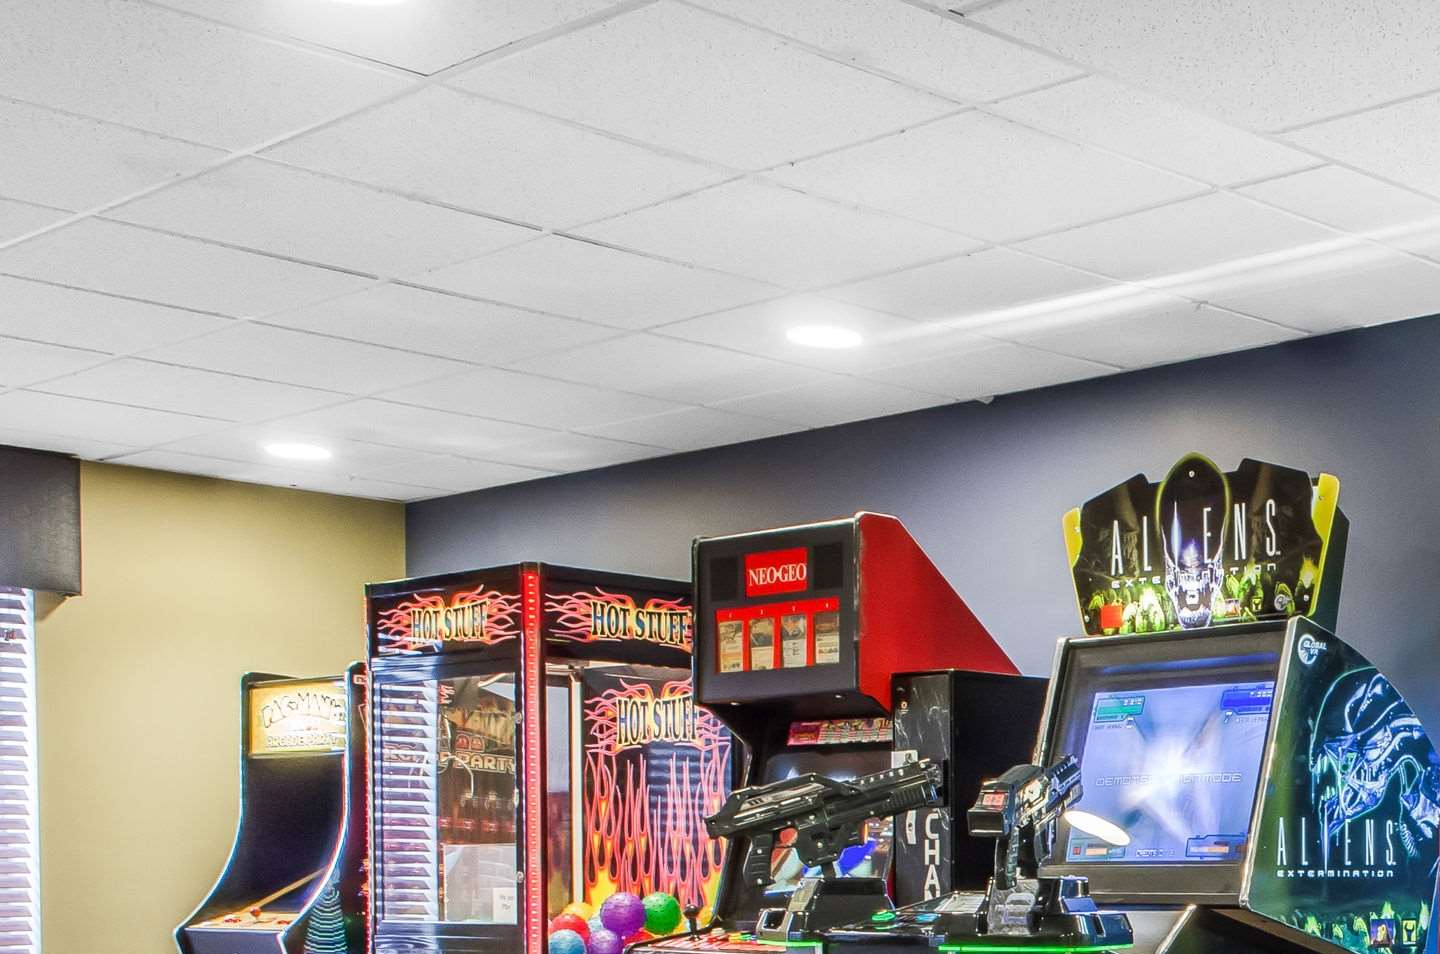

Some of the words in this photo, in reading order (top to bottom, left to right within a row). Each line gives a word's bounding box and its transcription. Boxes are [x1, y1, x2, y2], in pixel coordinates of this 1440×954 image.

[1111, 498, 1277, 578] ALIENS
[411, 607, 441, 640] HOT
[444, 601, 489, 640] STUFF
[591, 600, 633, 638] HOT
[635, 609, 691, 644] STUFF
[616, 698, 650, 745] HOT
[652, 693, 698, 742] STUFF
[1205, 772, 1242, 784] MODE
[1277, 815, 1396, 868] ALIENS
[1277, 869, 1394, 878] EXTERMINATION
